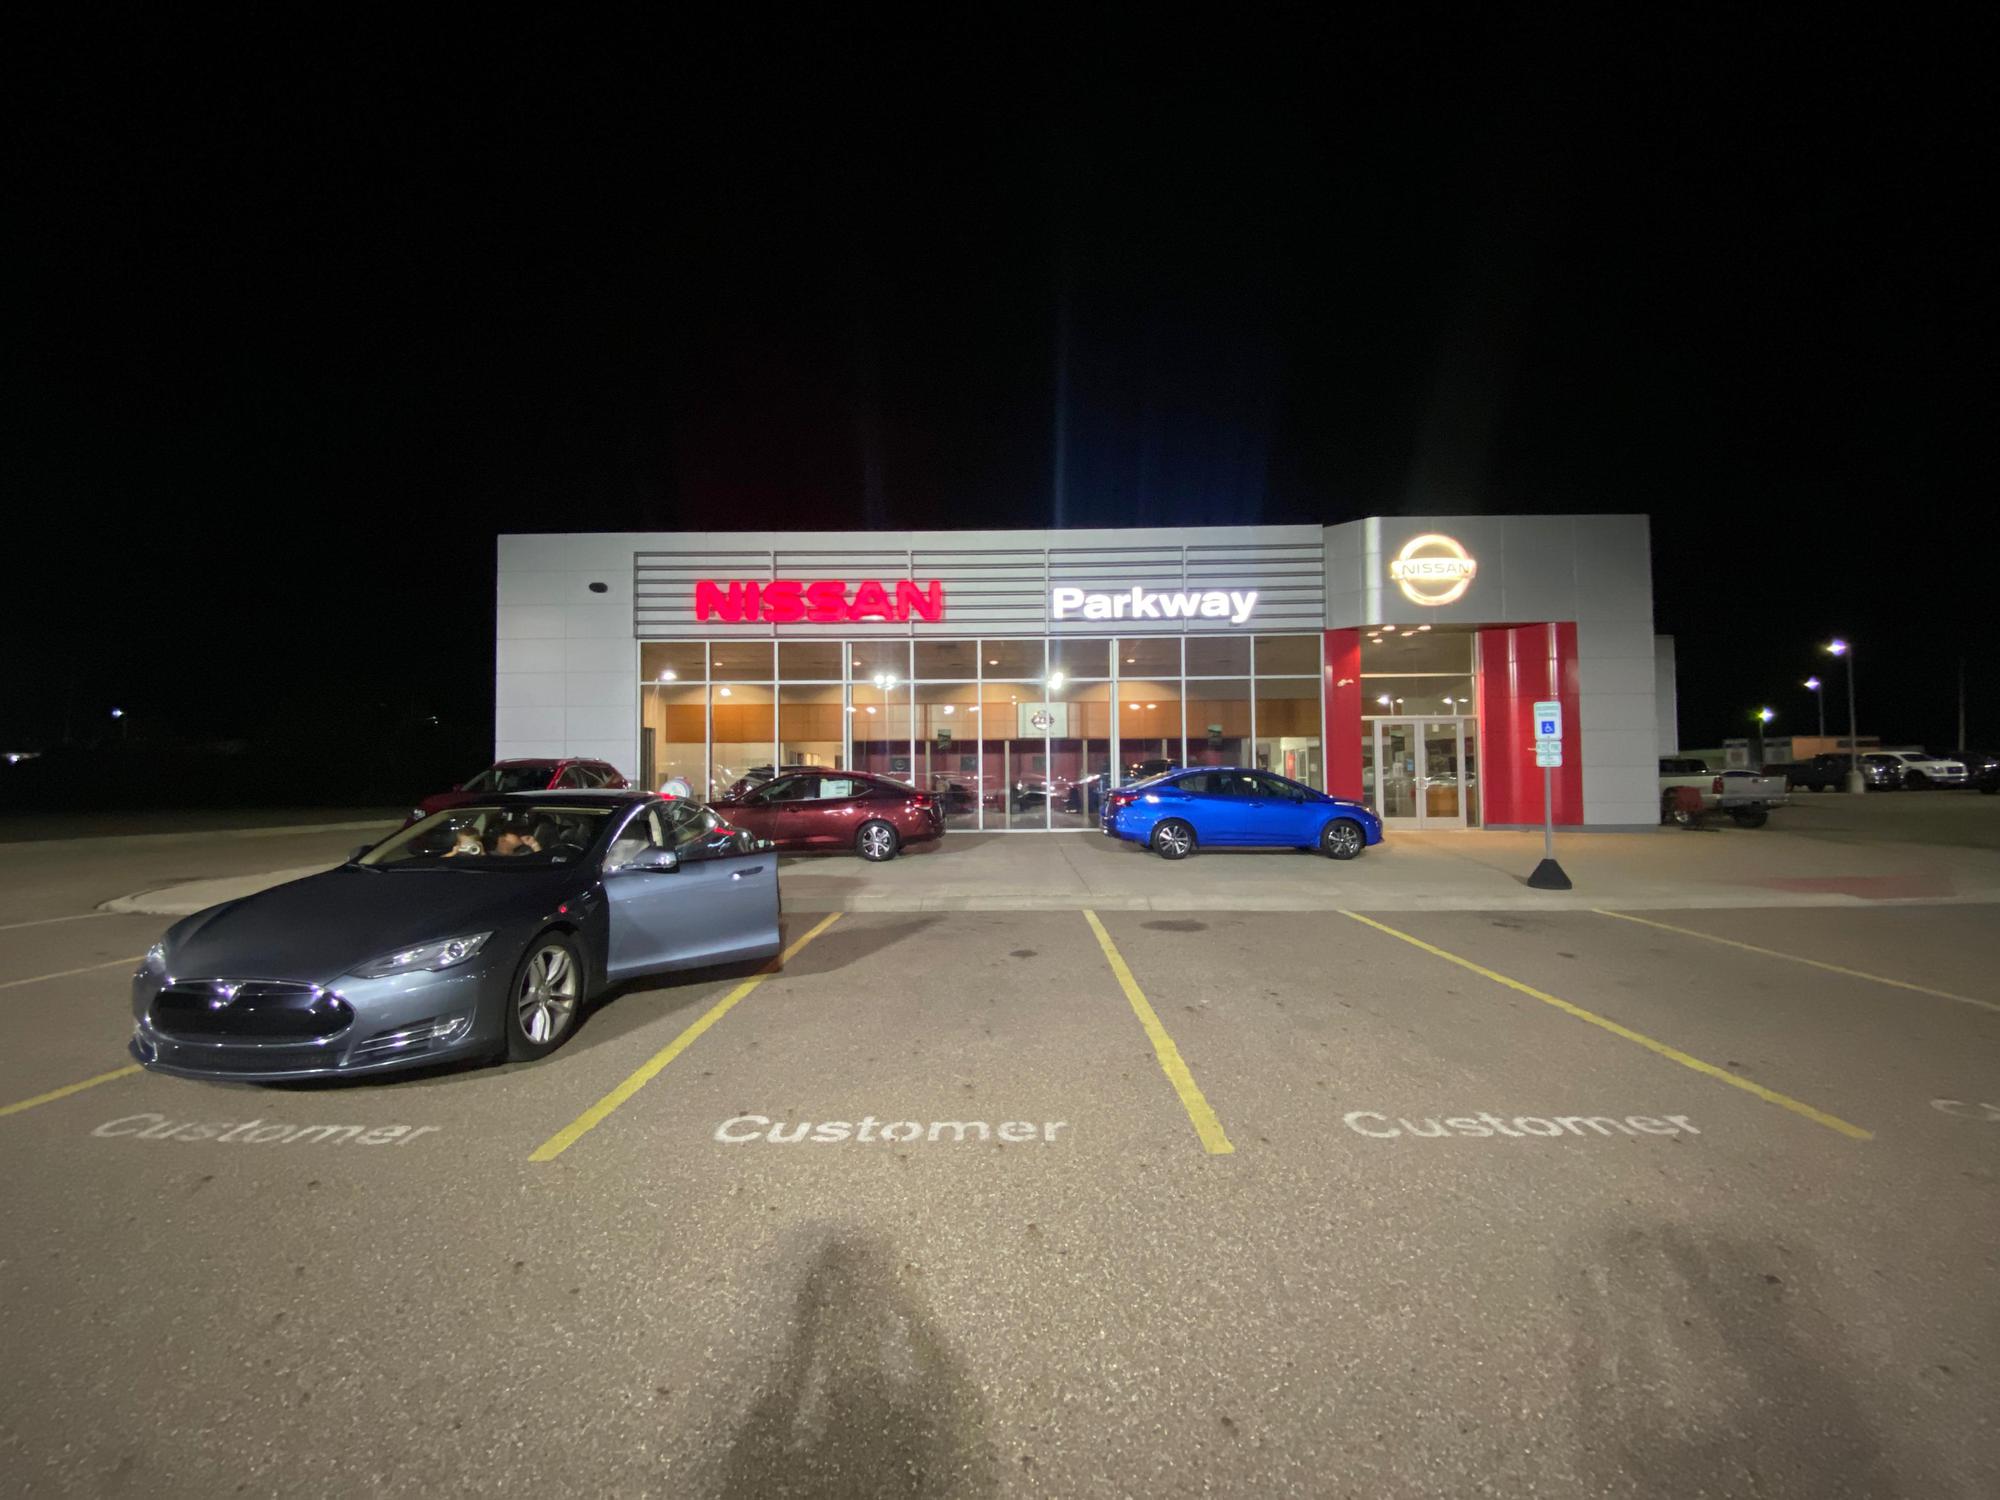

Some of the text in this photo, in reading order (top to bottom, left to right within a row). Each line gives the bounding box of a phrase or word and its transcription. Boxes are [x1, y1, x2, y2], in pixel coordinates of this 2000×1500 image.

[1402, 562, 1470, 575] NISSAN
[695, 580, 943, 622] NISSAN
[1052, 586, 1259, 624] Parkway
[93, 1112, 441, 1146] Customer
[714, 1115, 1067, 1144] Customer
[1342, 1110, 1702, 1138] Customer
